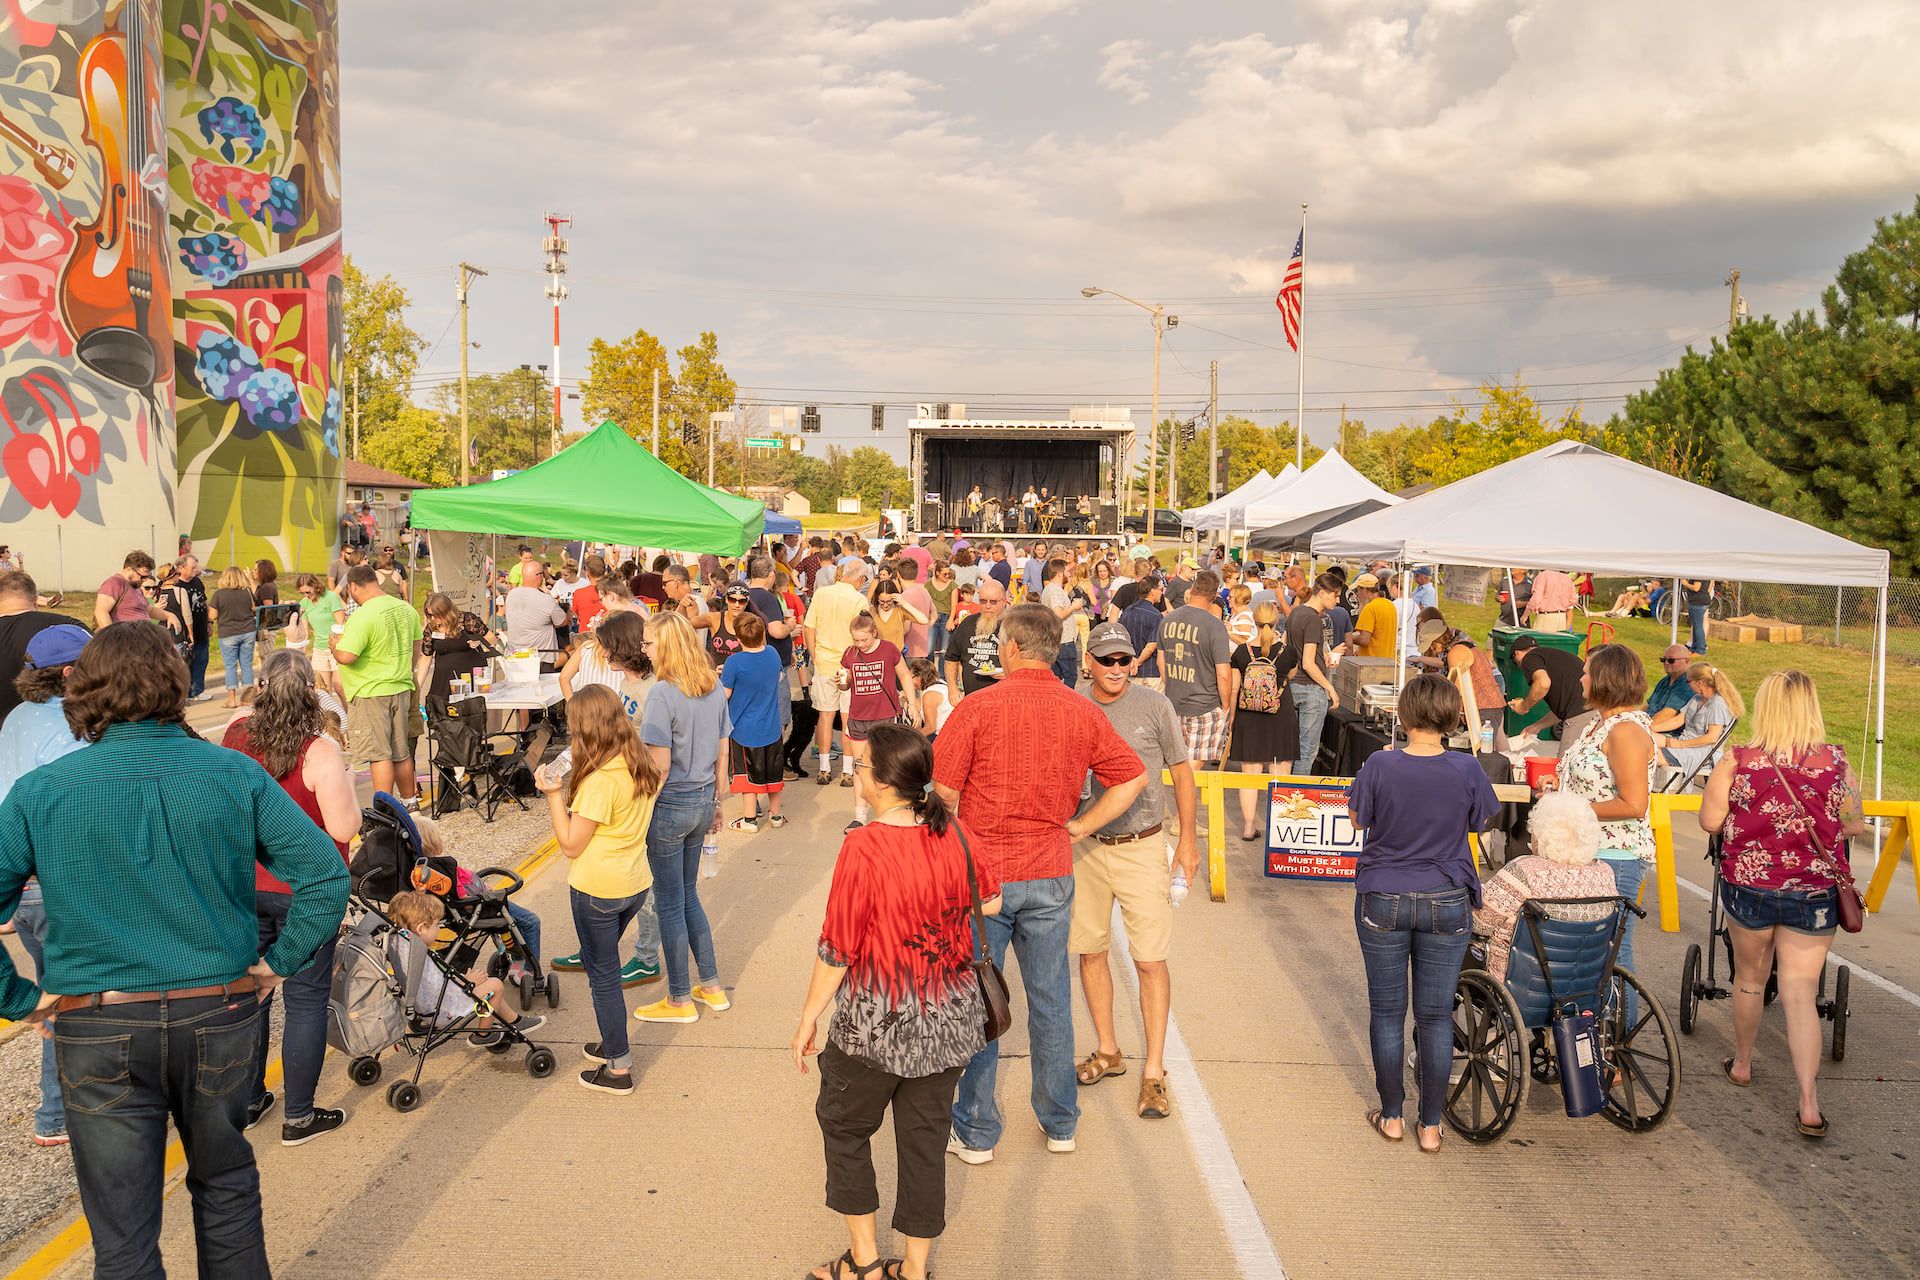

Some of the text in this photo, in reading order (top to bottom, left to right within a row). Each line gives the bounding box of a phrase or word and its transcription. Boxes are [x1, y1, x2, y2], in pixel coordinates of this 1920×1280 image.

[1163, 621, 1200, 645] LOCAL
[1166, 663, 1196, 683] LAVOR
[1276, 814, 1360, 847] WE I.D.
[1273, 864, 1297, 873] WITH
[1311, 866, 1324, 874] TO
[1326, 868, 1356, 876] ENTER
[1288, 856, 1341, 866] MUST BE 21
